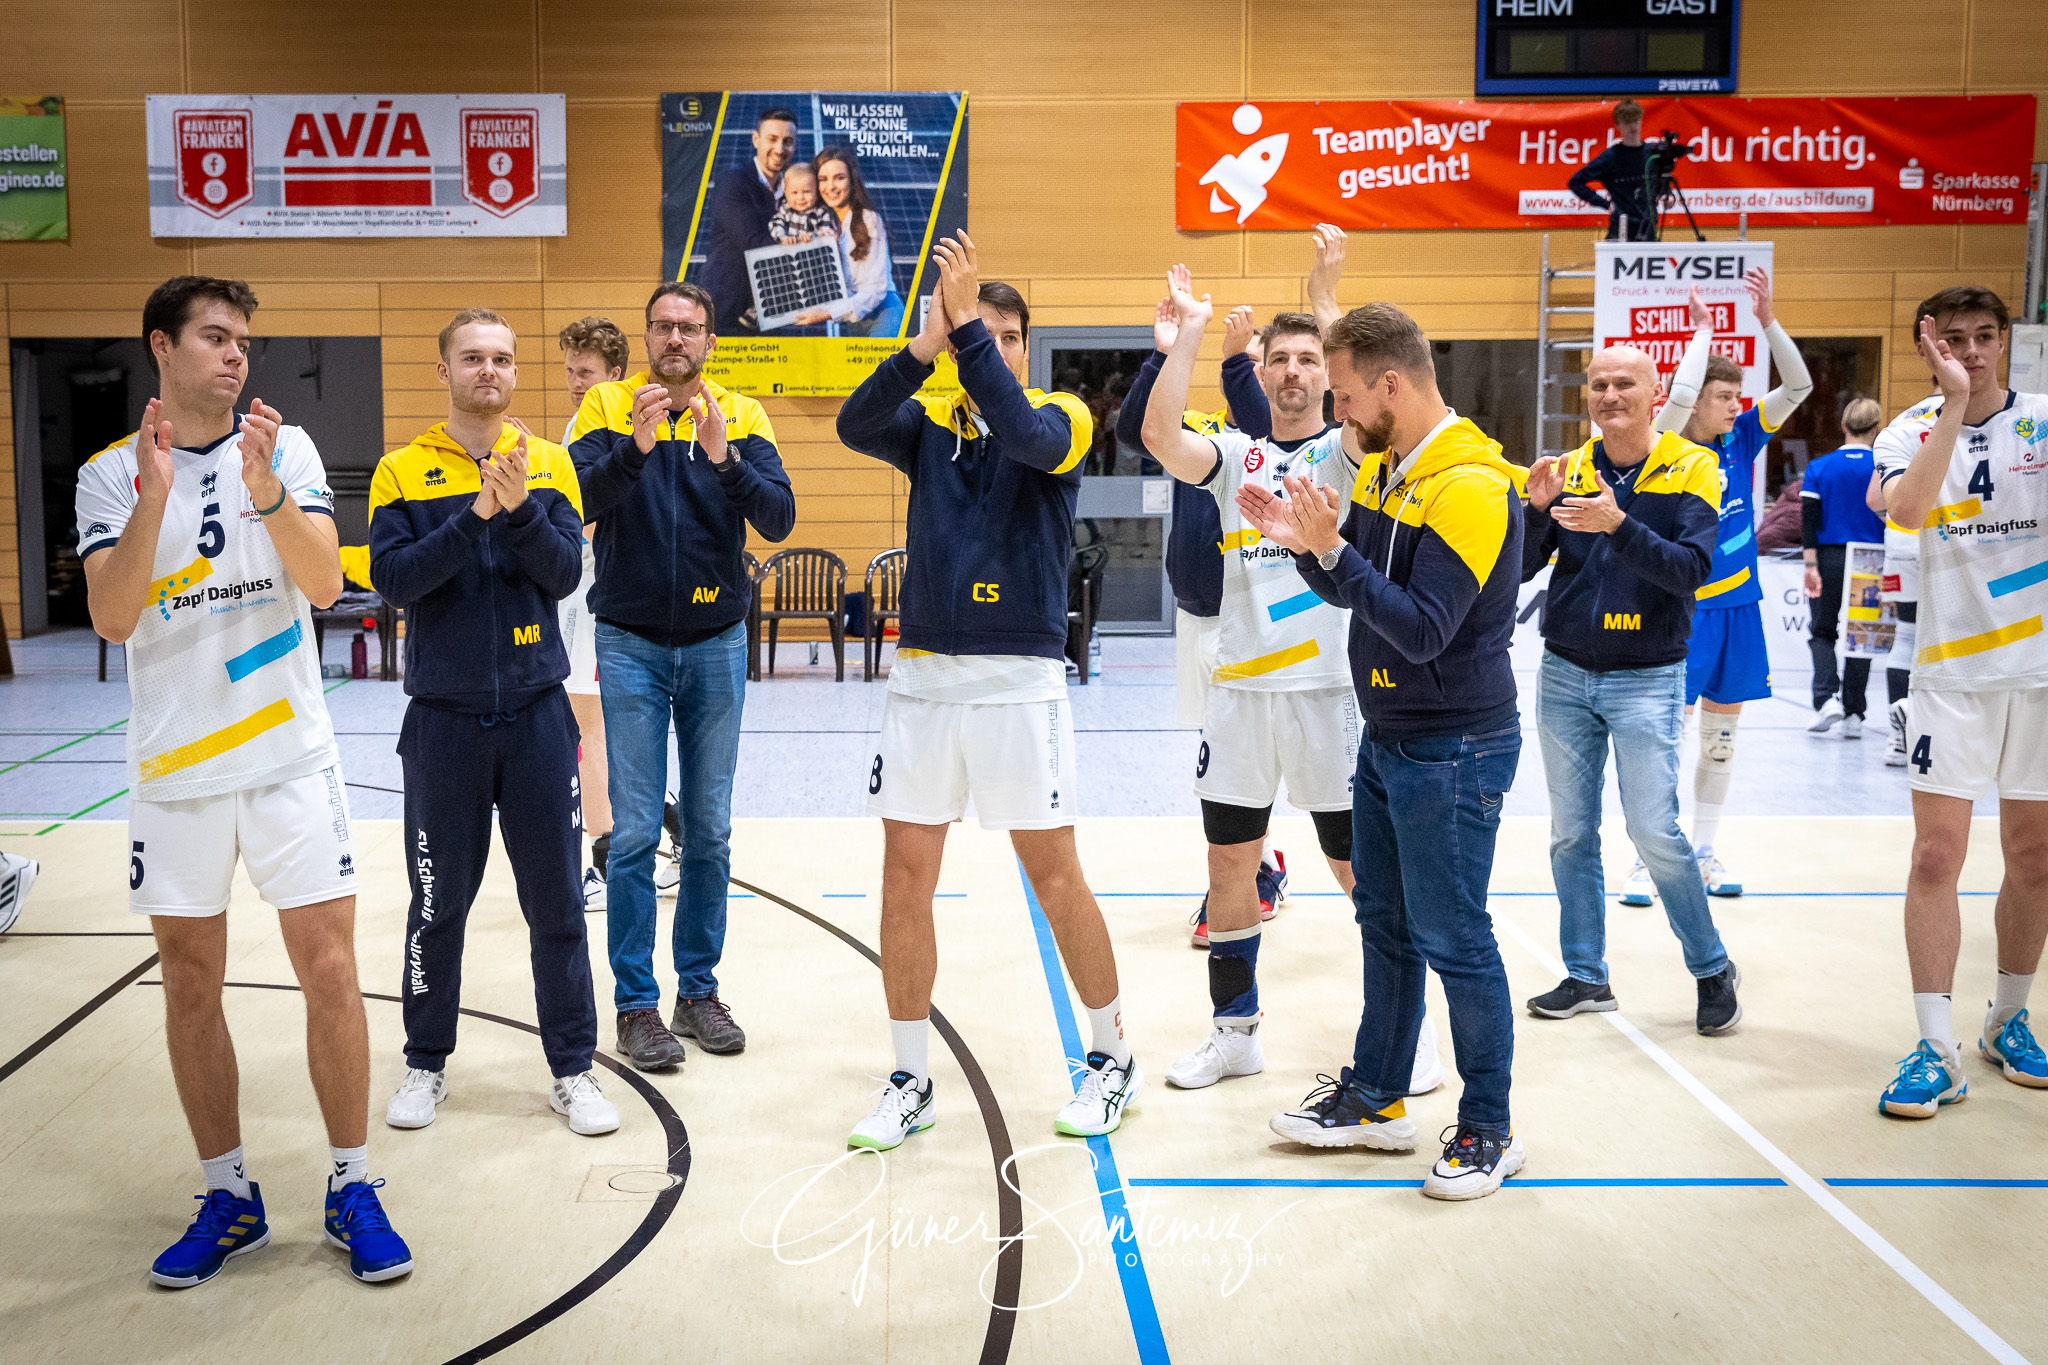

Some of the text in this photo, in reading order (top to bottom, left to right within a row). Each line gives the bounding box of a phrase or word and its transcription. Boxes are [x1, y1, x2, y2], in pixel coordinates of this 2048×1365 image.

[1495, 0, 1573, 17] HEIM
[1646, 0, 1718, 15] GAST
[1658, 79, 1720, 91] PEWETA
[822, 103, 904, 117] WIR LASSEN
[183, 119, 244, 132] #AVIATEAM
[470, 118, 529, 132] #AVIATEAM
[669, 121, 713, 133] LEONDA
[835, 117, 908, 131] DIE SONNE
[183, 133, 245, 149] FRANKEN
[469, 132, 530, 149] FRANKEN
[849, 128, 913, 144] FÜR DICH
[1312, 117, 1492, 156] Teamplayer
[856, 143, 940, 158] STRAHLEN...
[1519, 129, 1598, 167] Hier
[1687, 128, 1734, 163] du
[1745, 126, 1877, 170] richtig.
[1338, 153, 1470, 198] gesucht!
[1931, 172, 2020, 191] Sparkasse
[1932, 194, 2014, 214] Nürnberg
[1612, 286, 1649, 297] Druck
[750, 343, 780, 352] GmbH
[777, 355, 789, 363] 10
[706, 367, 731, 376] Fürth
[1968, 459, 1995, 502] 4
[197, 502, 226, 559] 5
[1976, 519, 2038, 535] Daigfuss
[172, 578, 273, 611] Zapf Daigfuss
[692, 586, 720, 604] AW
[972, 582, 1000, 603] CS
[1603, 613, 1642, 630] MM
[513, 624, 541, 646] MR
[1371, 668, 1397, 688] AL
[1196, 740, 1211, 779] 9
[1911, 734, 1933, 775] 4
[868, 753, 884, 795] 8
[129, 840, 145, 891] 5
[417, 857, 435, 922] Schwaig
